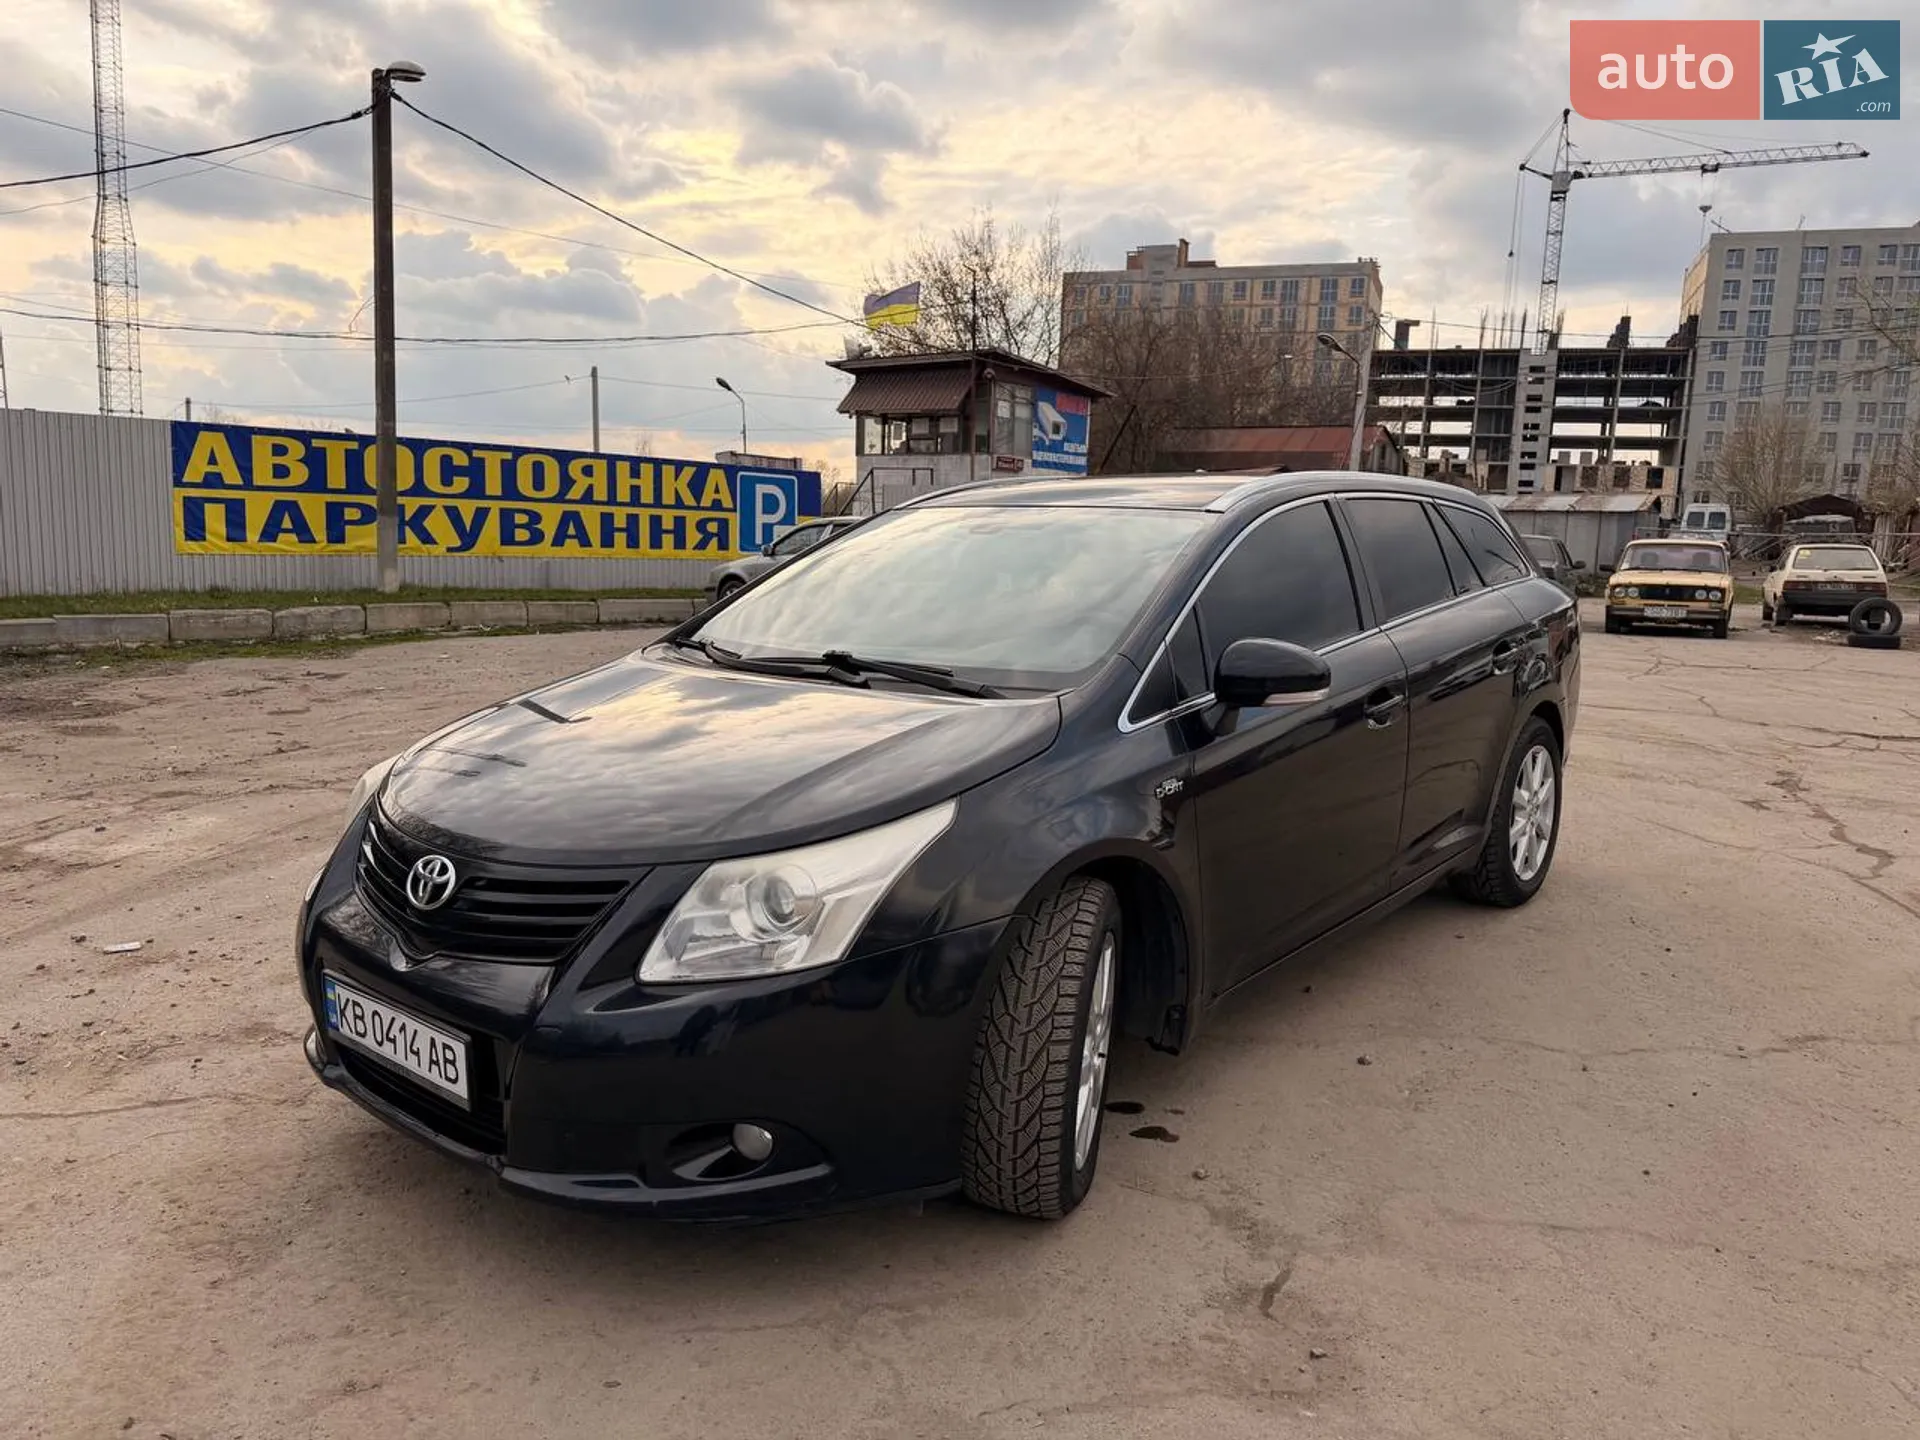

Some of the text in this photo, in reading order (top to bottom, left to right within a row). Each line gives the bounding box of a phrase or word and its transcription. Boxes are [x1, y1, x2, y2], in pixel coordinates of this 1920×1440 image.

[181, 430, 734, 508] АВТОСТОЯНКА
[183, 496, 730, 552] ПАРКУВАННЯ
[755, 483, 787, 545] P
[337, 992, 459, 1085] KB 0414 AB
